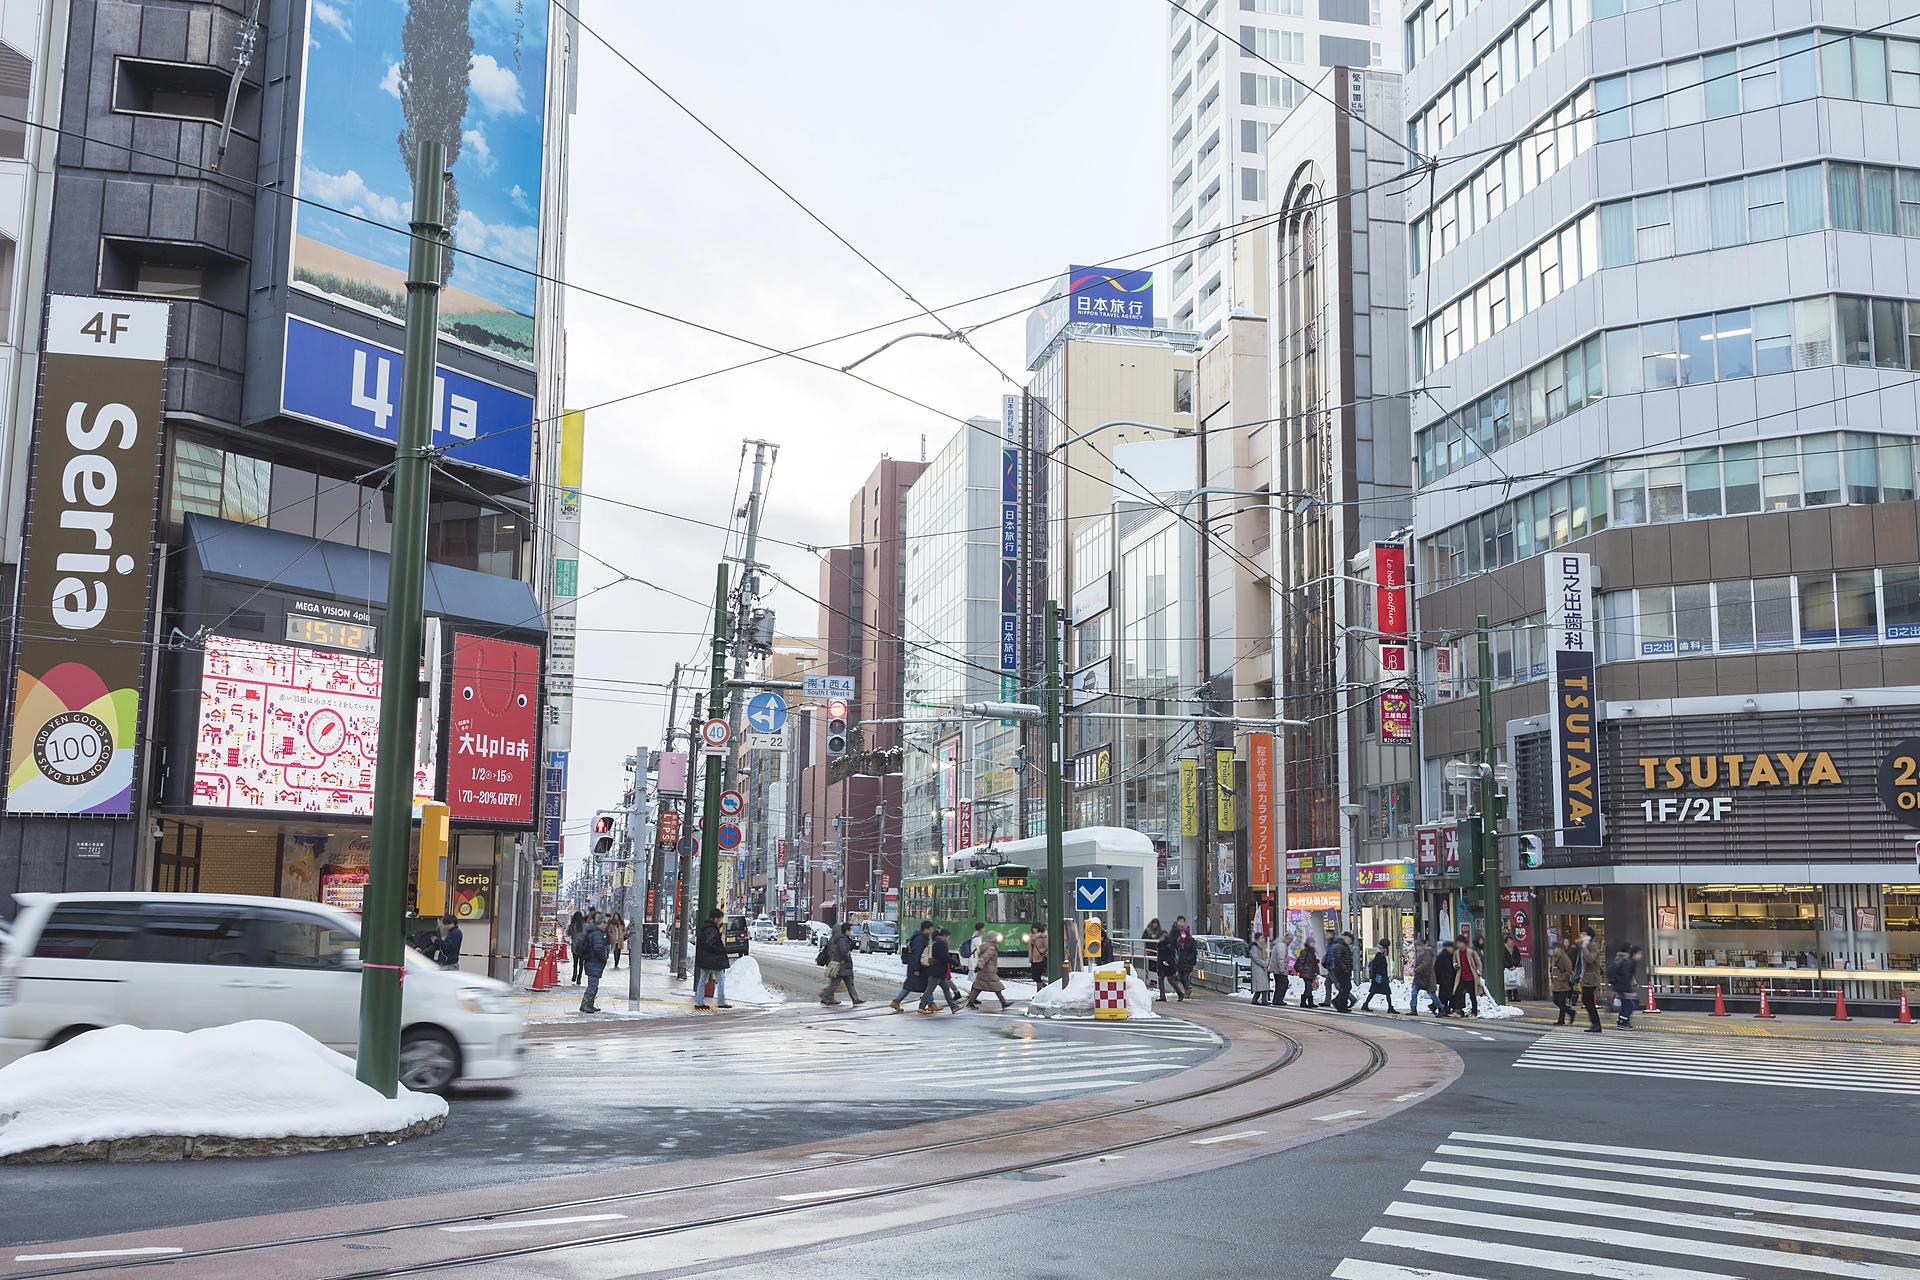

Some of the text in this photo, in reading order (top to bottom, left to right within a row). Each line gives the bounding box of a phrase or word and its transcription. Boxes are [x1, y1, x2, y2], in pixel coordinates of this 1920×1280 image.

[1078, 296, 1143, 315] 日本旅行
[80, 311, 131, 344] 4F
[351, 349, 478, 440] 4la
[52, 401, 138, 631] Seria
[1005, 510, 1015, 552] 日本旅行
[295, 601, 319, 613] MEGA
[322, 605, 350, 618] VISION
[1562, 557, 1584, 650] 日之出歯科
[305, 620, 363, 648] 15:12
[1003, 621, 1014, 664] 日本旅行
[1643, 640, 1701, 654] 日之出 歯科
[807, 678, 850, 690] 南1西4
[37, 714, 107, 747] 100 YEN GOODS
[708, 726, 725, 739] 40
[49, 734, 97, 763] 100
[1564, 675, 1594, 824] TSUTAYA
[38, 745, 111, 783] COLOR THE DAYS
[1639, 752, 1842, 790] TSUTAYA
[1893, 756, 1920, 786] 2
[498, 792, 518, 806] OFF!
[1640, 796, 1733, 822] 1F/2F
[662, 814, 672, 840] LIPS
[457, 873, 490, 885] Seria
